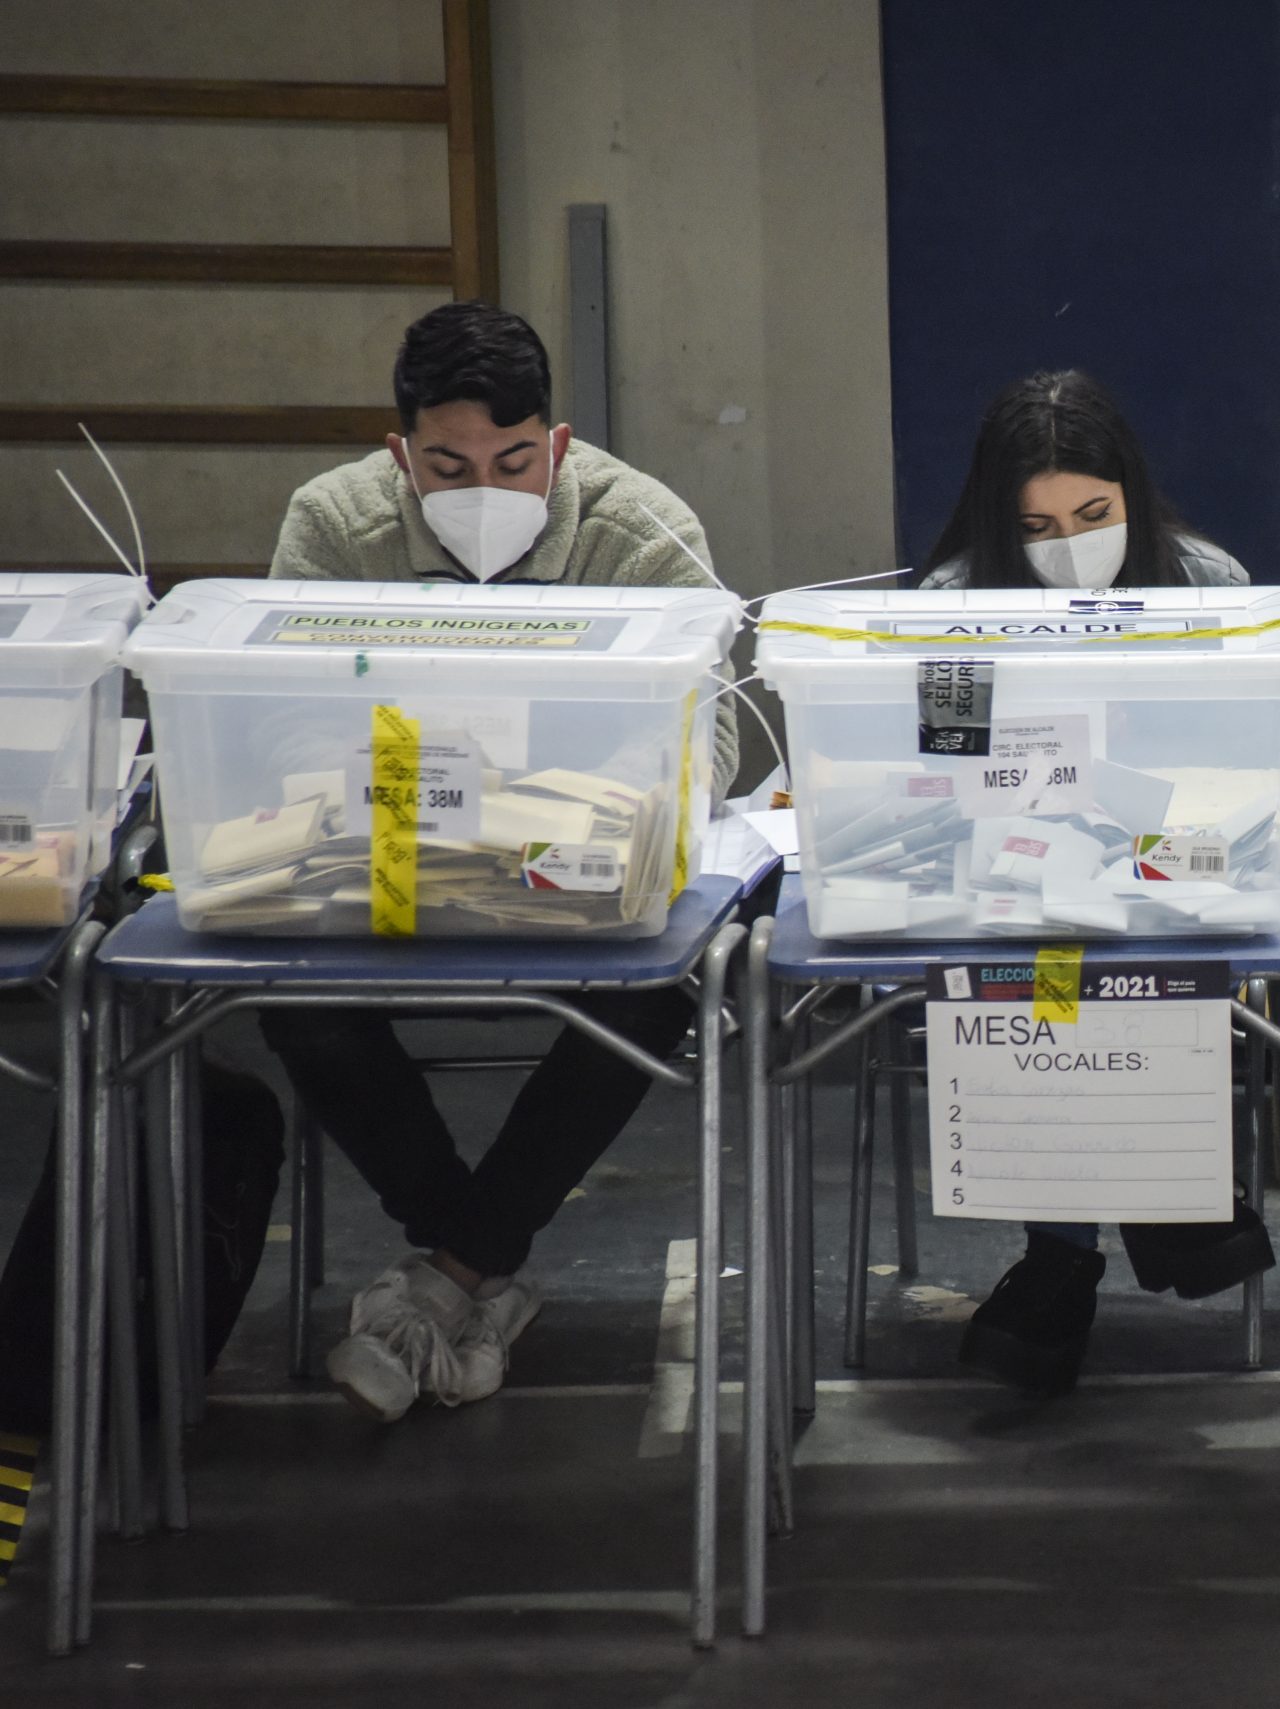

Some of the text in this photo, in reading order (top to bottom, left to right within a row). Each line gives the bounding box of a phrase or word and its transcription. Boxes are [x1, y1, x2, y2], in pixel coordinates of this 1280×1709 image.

[294, 617, 578, 631] PUEBLOS INDÍGENAS
[944, 624, 1137, 634] ALCALDE
[935, 658, 953, 708] SELLO
[1015, 742, 1063, 750] ELECTORAL
[428, 789, 464, 809] 38M
[1151, 854, 1182, 863] Kendy
[1099, 976, 1159, 998] 2021
[955, 1015, 1056, 1046] MESA
[1014, 1053, 1150, 1071] VOCALES:
[950, 1077, 959, 1095] 1
[949, 1104, 962, 1123] 2
[950, 1132, 962, 1150] 3
[950, 1160, 963, 1178] 4
[952, 1187, 965, 1206] 5
